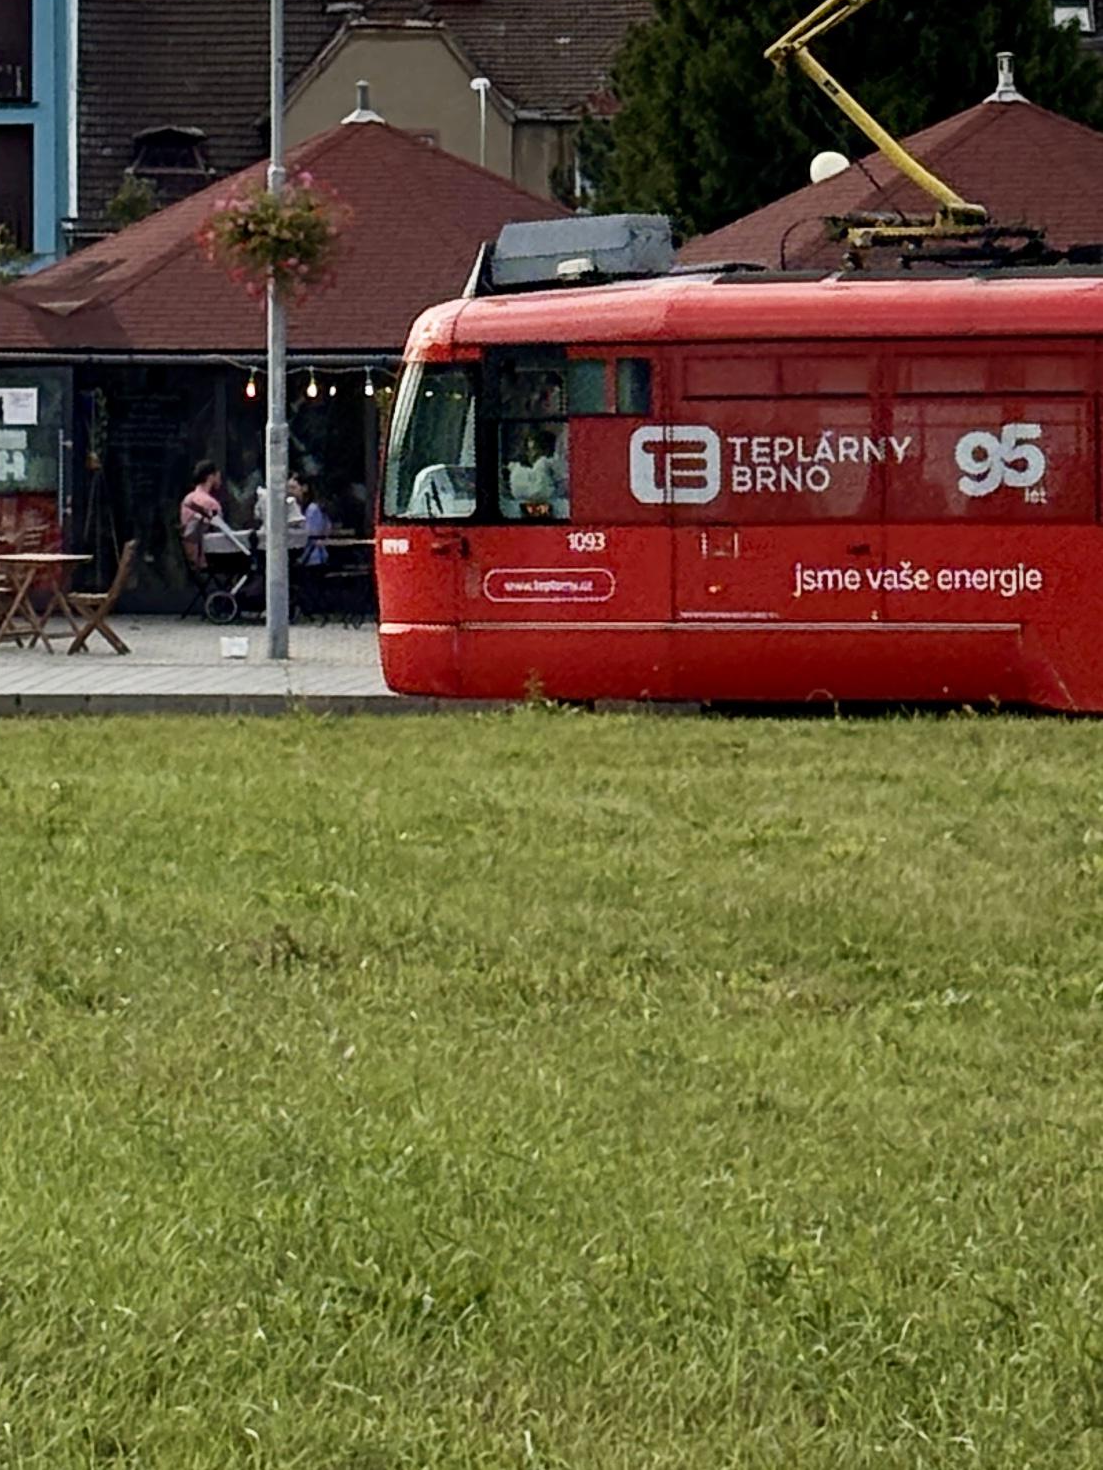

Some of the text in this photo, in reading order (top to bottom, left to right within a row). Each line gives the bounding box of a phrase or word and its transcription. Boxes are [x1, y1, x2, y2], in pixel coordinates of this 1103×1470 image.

[727, 431, 912, 464] TEPLÁRNY
[955, 422, 1046, 498] 95
[731, 464, 832, 493] BRNO
[567, 532, 606, 551] 1093
[792, 560, 1043, 598] jsme vaše energie
